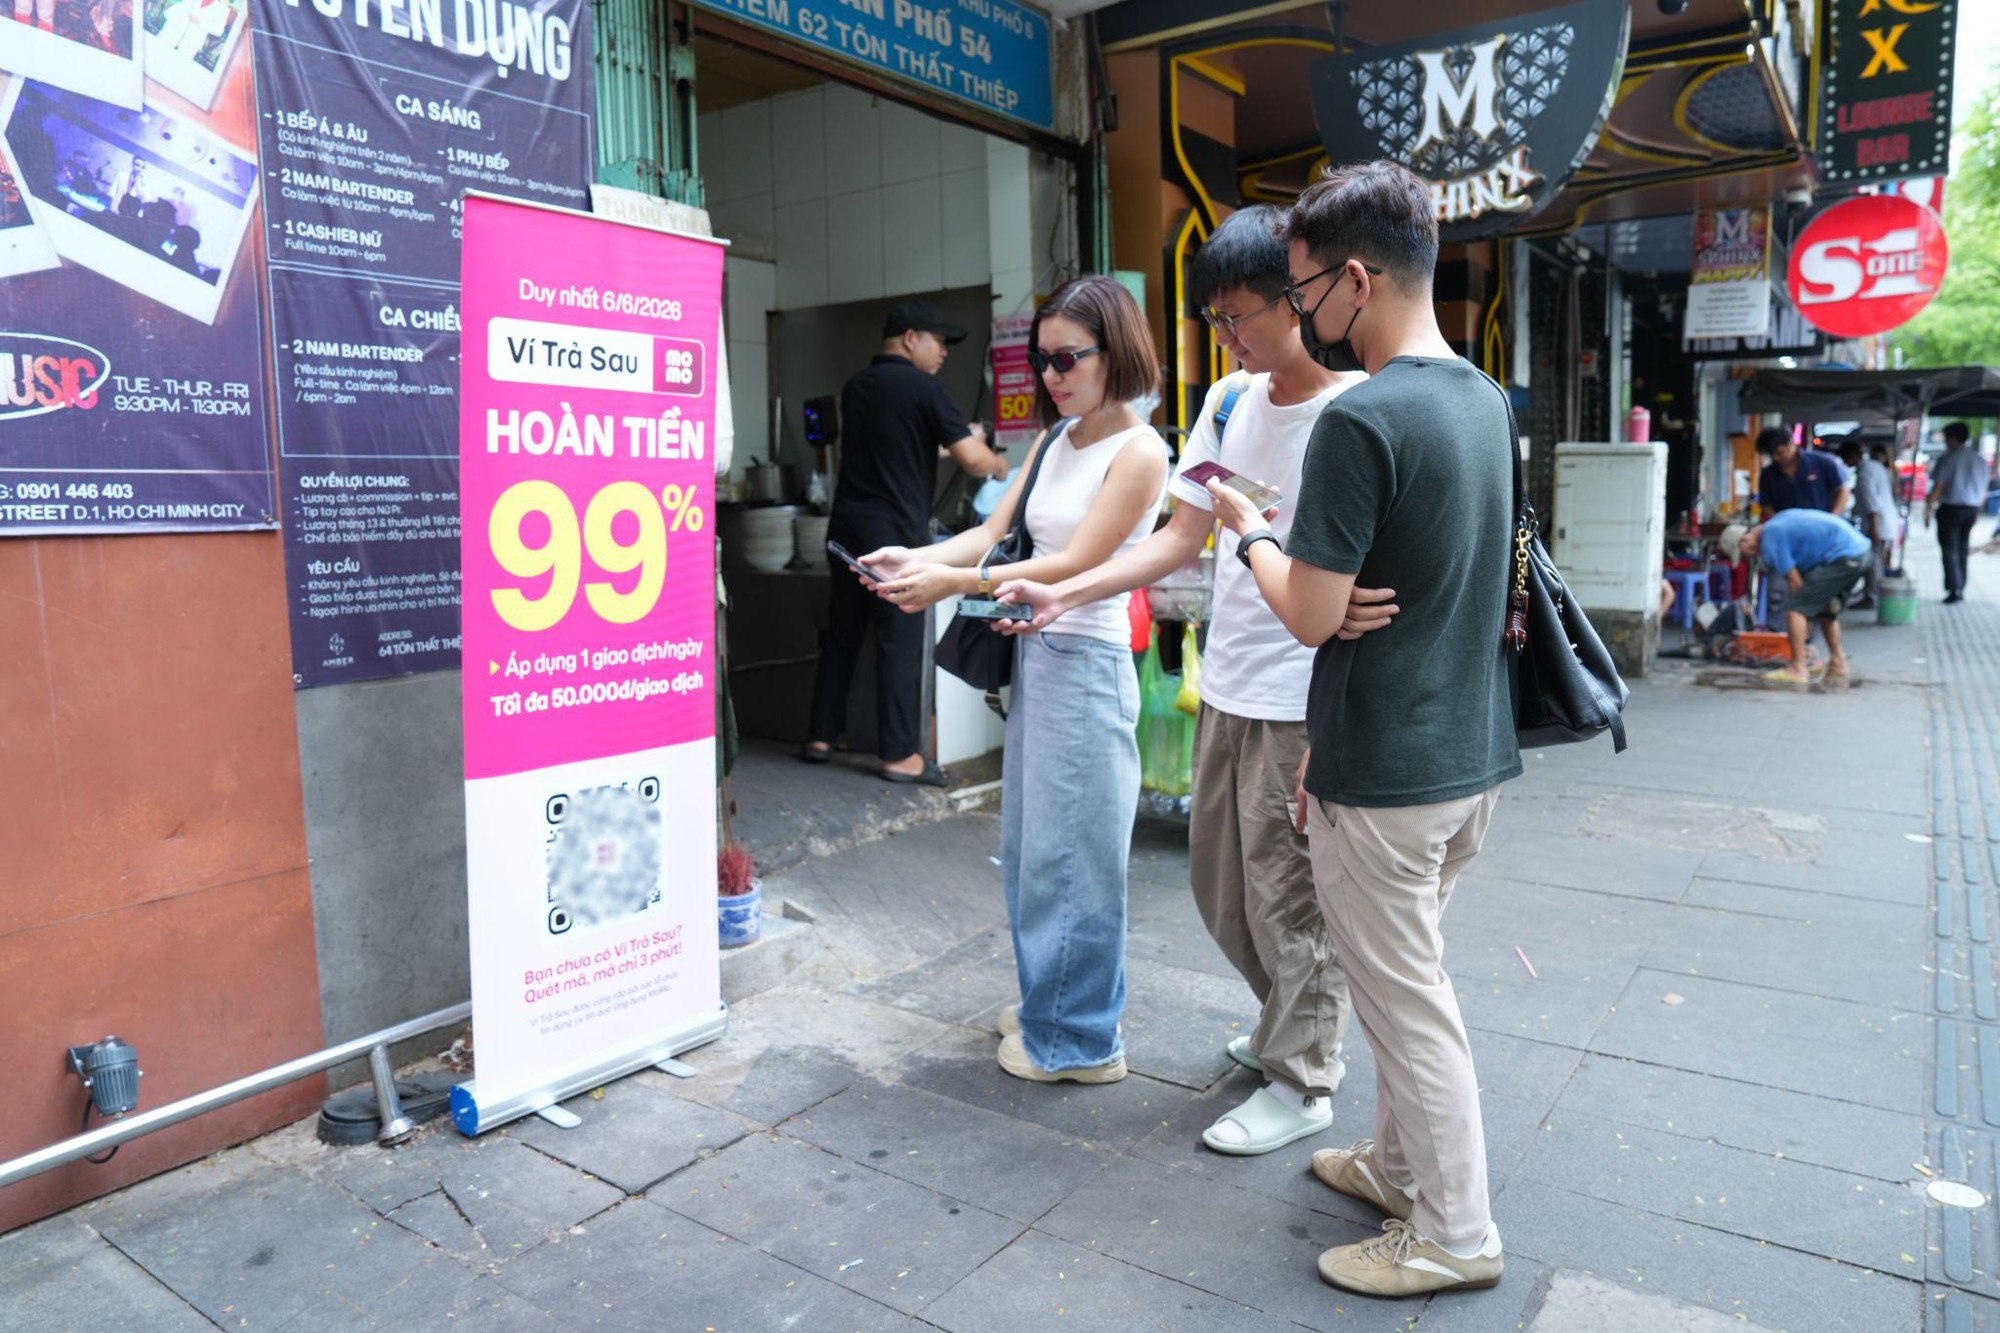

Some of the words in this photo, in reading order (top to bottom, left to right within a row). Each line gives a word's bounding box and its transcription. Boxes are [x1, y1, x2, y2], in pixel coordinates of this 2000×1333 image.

[455, 0, 571, 80] DỤNG
[798, 8, 829, 41] 62
[833, 20, 888, 63] TÔN
[893, 44, 956, 87] THẤT
[960, 25, 992, 64] 54
[396, 94, 425, 118] CA
[428, 99, 481, 131] SÁNG
[1412, 34, 1507, 154] M
[1837, 91, 1934, 133] LOUNGE
[333, 123, 345, 140] &
[1857, 133, 1910, 166] BAR
[281, 168, 292, 183] 2
[293, 171, 331, 192] NAM
[332, 178, 415, 207] BARTENDER
[1430, 145, 1536, 222] HINX
[285, 219, 295, 235] 1
[296, 221, 358, 245] CASHIER
[380, 306, 407, 328] CA
[519, 278, 557, 308] Duy
[560, 286, 599, 311] nhất
[602, 291, 682, 321] 6/6/2026
[293, 339, 304, 355] 2
[306, 341, 340, 357] NAM
[342, 344, 424, 363] BARTENDER
[507, 336, 536, 365] Ví
[542, 340, 582, 370] Trả
[590, 346, 638, 375] Sau
[112, 376, 150, 394] TUE
[163, 379, 212, 397] THUR
[223, 382, 249, 399] FRI
[1000, 394, 1034, 420] 50
[486, 401, 614, 458] HOÀN
[622, 405, 705, 460] TIỀN
[17, 483, 61, 500] 0901
[65, 483, 99, 500] 446
[102, 483, 134, 500] 403
[108, 504, 137, 519] HO
[138, 504, 165, 519] CHI
[168, 503, 208, 518] MINH
[210, 503, 245, 518] CITY
[504, 651, 531, 679] Áp
[534, 653, 577, 676] dụng
[580, 648, 589, 668] 1
[592, 647, 629, 670] giao
[631, 637, 704, 666] dịch/ngày
[490, 691, 521, 717] Tối
[524, 691, 549, 713] đa
[551, 677, 669, 710] 50.000đ/giao
[671, 671, 704, 696] dịch
[525, 968, 553, 985] Bạn
[556, 955, 591, 976] chưa
[594, 947, 611, 963] có
[614, 941, 628, 958] Ví
[630, 935, 649, 952] Trả
[652, 924, 683, 945] Sau?
[525, 980, 560, 1004] Quét
[563, 972, 590, 992] mã,
[593, 963, 615, 982] mở
[618, 954, 637, 974] chỉ
[640, 953, 648, 967] 3
[650, 941, 682, 966] phút!
